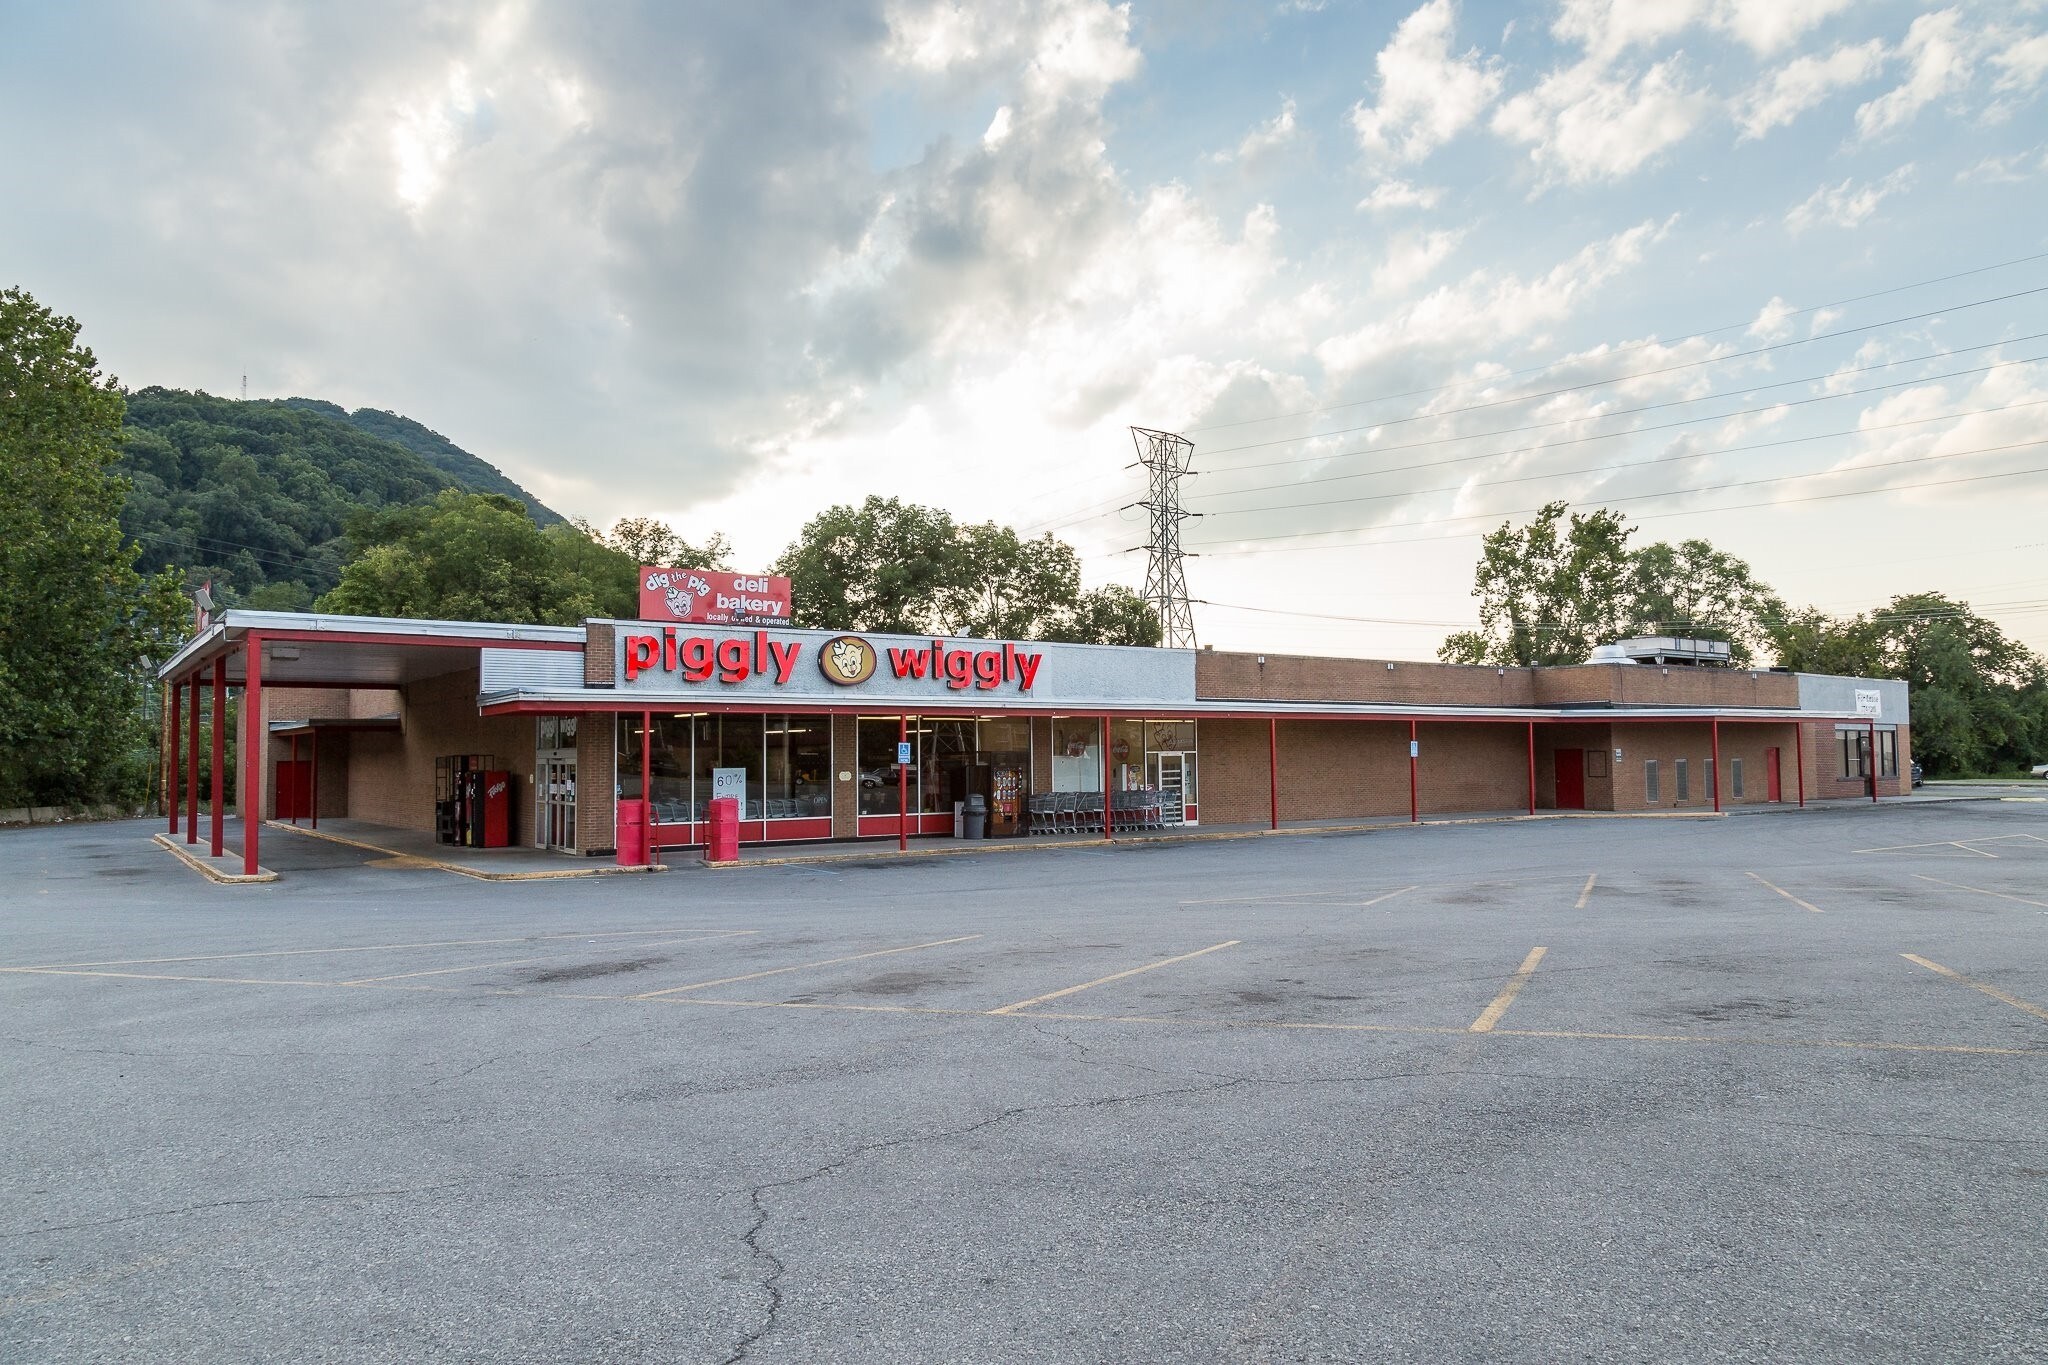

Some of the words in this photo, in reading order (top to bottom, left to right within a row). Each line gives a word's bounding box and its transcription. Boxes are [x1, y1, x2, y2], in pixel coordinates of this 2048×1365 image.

[646, 573, 670, 591] dig
[671, 572, 688, 582] the
[687, 575, 711, 597] pig
[733, 576, 769, 593] deli
[716, 593, 783, 615] bakery
[706, 612, 729, 622] locally
[762, 617, 790, 626] operated
[625, 627, 803, 684] piggly
[887, 640, 1043, 691] wiggly
[717, 774, 743, 787] 60%
